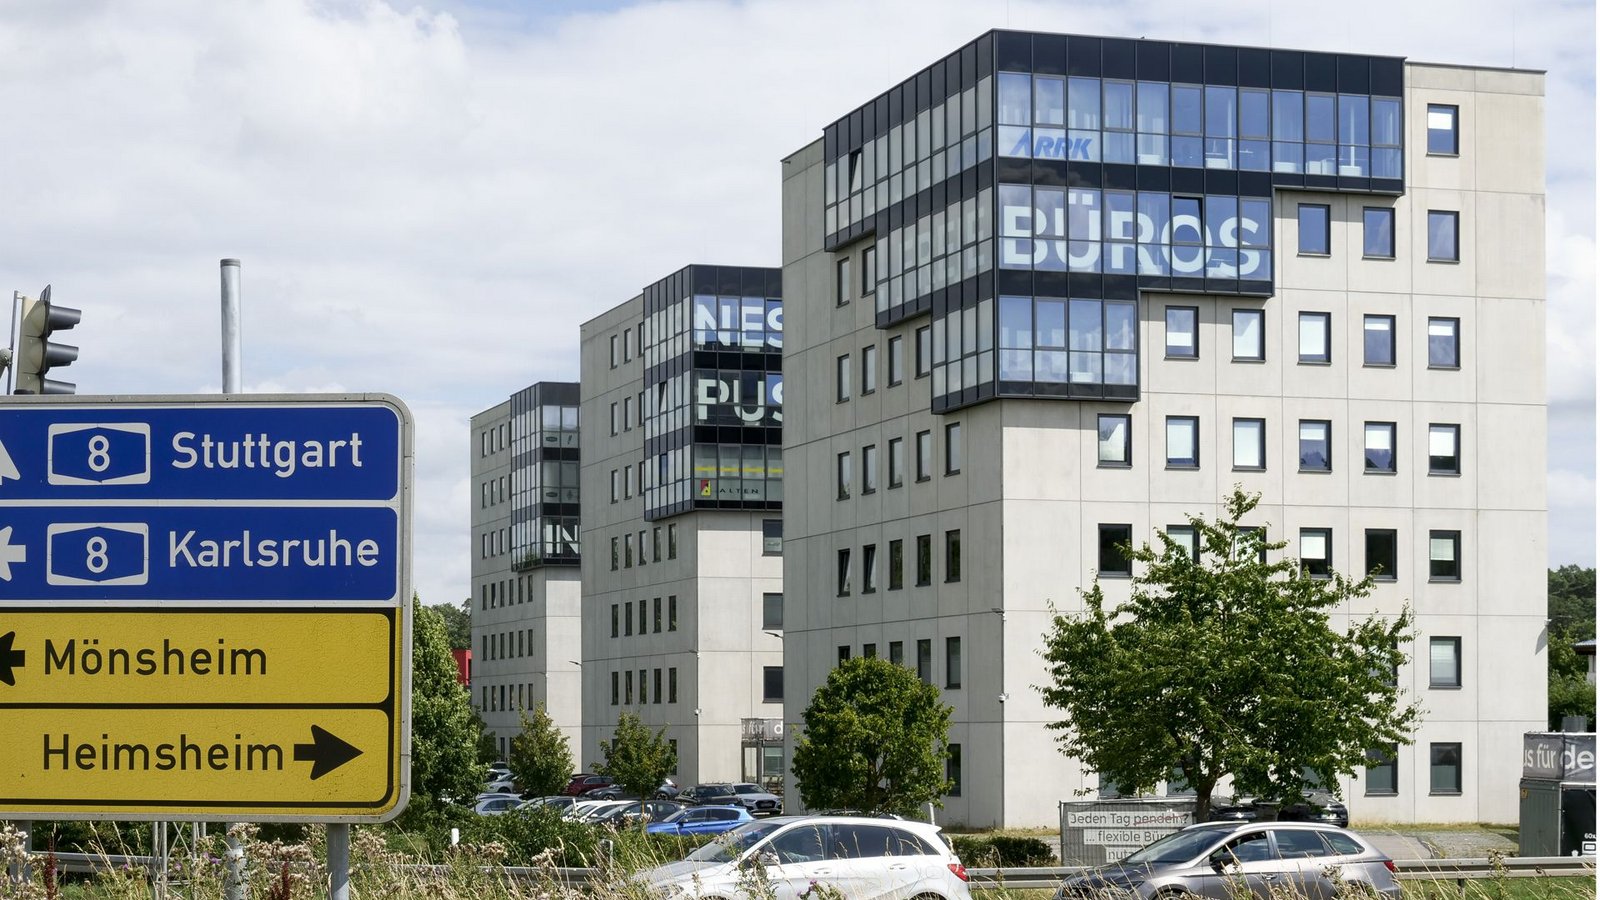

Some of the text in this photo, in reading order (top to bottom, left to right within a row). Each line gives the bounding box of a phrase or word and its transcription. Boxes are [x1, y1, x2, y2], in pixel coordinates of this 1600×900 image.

[1009, 129, 1093, 160] ARRK
[1003, 192, 1260, 278] BÜROS
[88, 432, 363, 478] 8 Stuttgart
[86, 529, 380, 573] 8 Karlsruhe
[44, 638, 268, 676] Mönsheim
[43, 733, 284, 771] Heimsheim
[1536, 743, 1556, 769] für
[1070, 812, 1189, 827] Jeden Tag pendeln?
[1098, 831, 1141, 842] flexible
